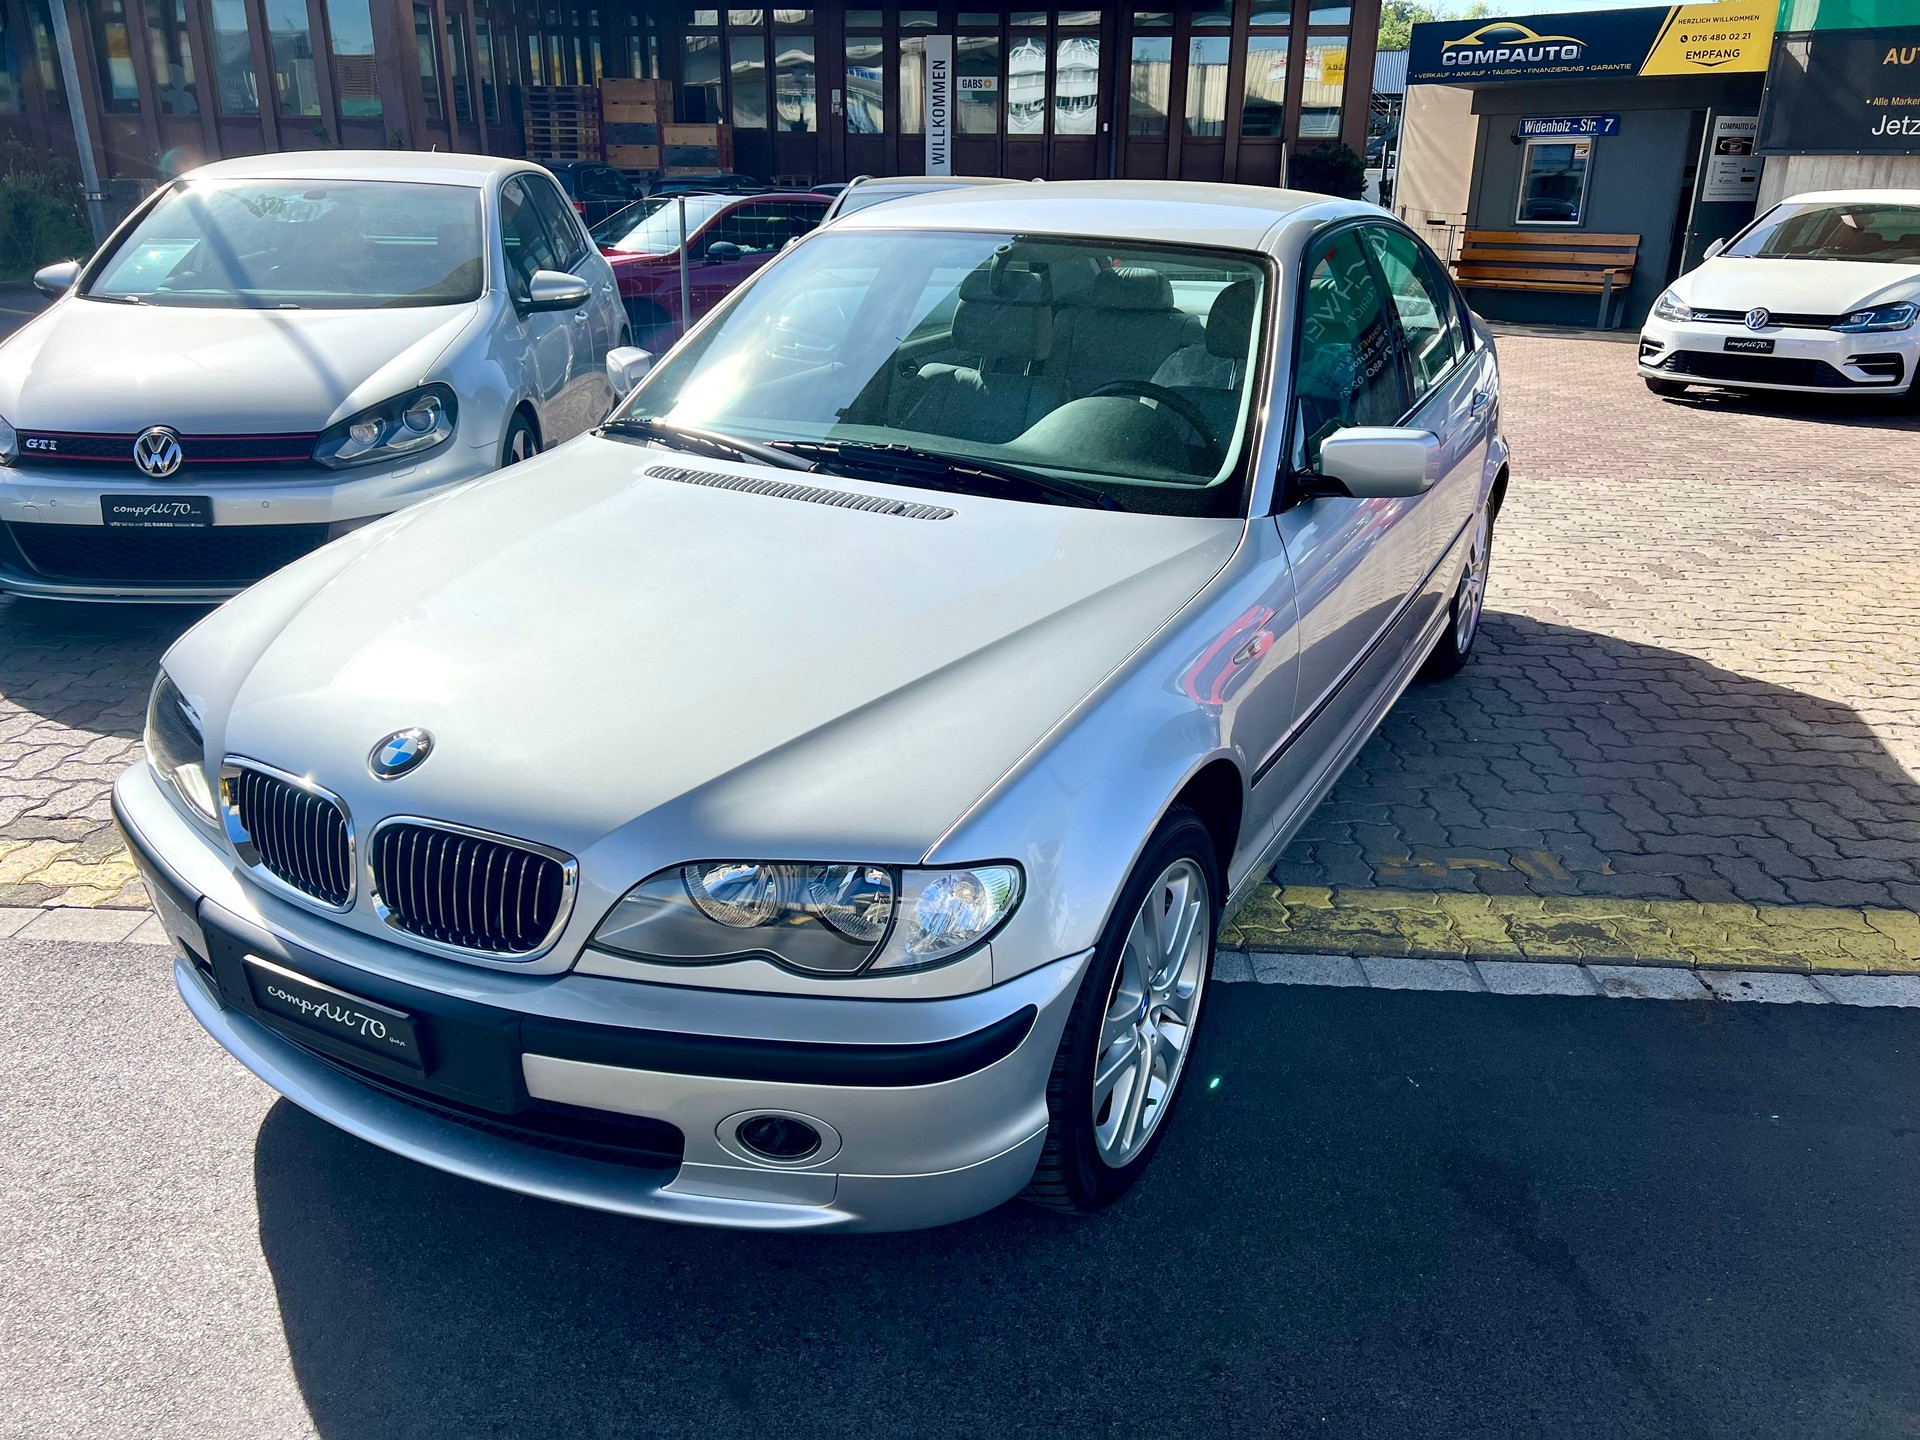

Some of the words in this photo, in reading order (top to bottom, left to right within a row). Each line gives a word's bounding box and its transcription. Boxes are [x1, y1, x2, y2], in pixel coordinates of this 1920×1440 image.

[1678, 17, 1711, 25] HERZLICH
[1712, 15, 1760, 23] WILLKOMMEN
[1691, 35, 1708, 43] 076
[1742, 32, 1752, 40] 21
[1442, 45, 1578, 66] COMPAUTO
[1685, 49, 1741, 60] EMPFANG
[1418, 71, 1450, 79] VERKAUF
[1456, 69, 1486, 77] ANKAUF
[1527, 65, 1585, 74] FINANZIERUNG
[1591, 63, 1632, 71] GARANTIE
[1873, 97, 1889, 106] Alle
[932, 60, 946, 166] WILLKOMMEN
[1524, 119, 1572, 133] Widenholz
[1580, 118, 1597, 132] Str.
[1604, 118, 1615, 132] 7
[1720, 122, 1749, 130] COMPAUTO
[25, 438, 57, 451] GTI
